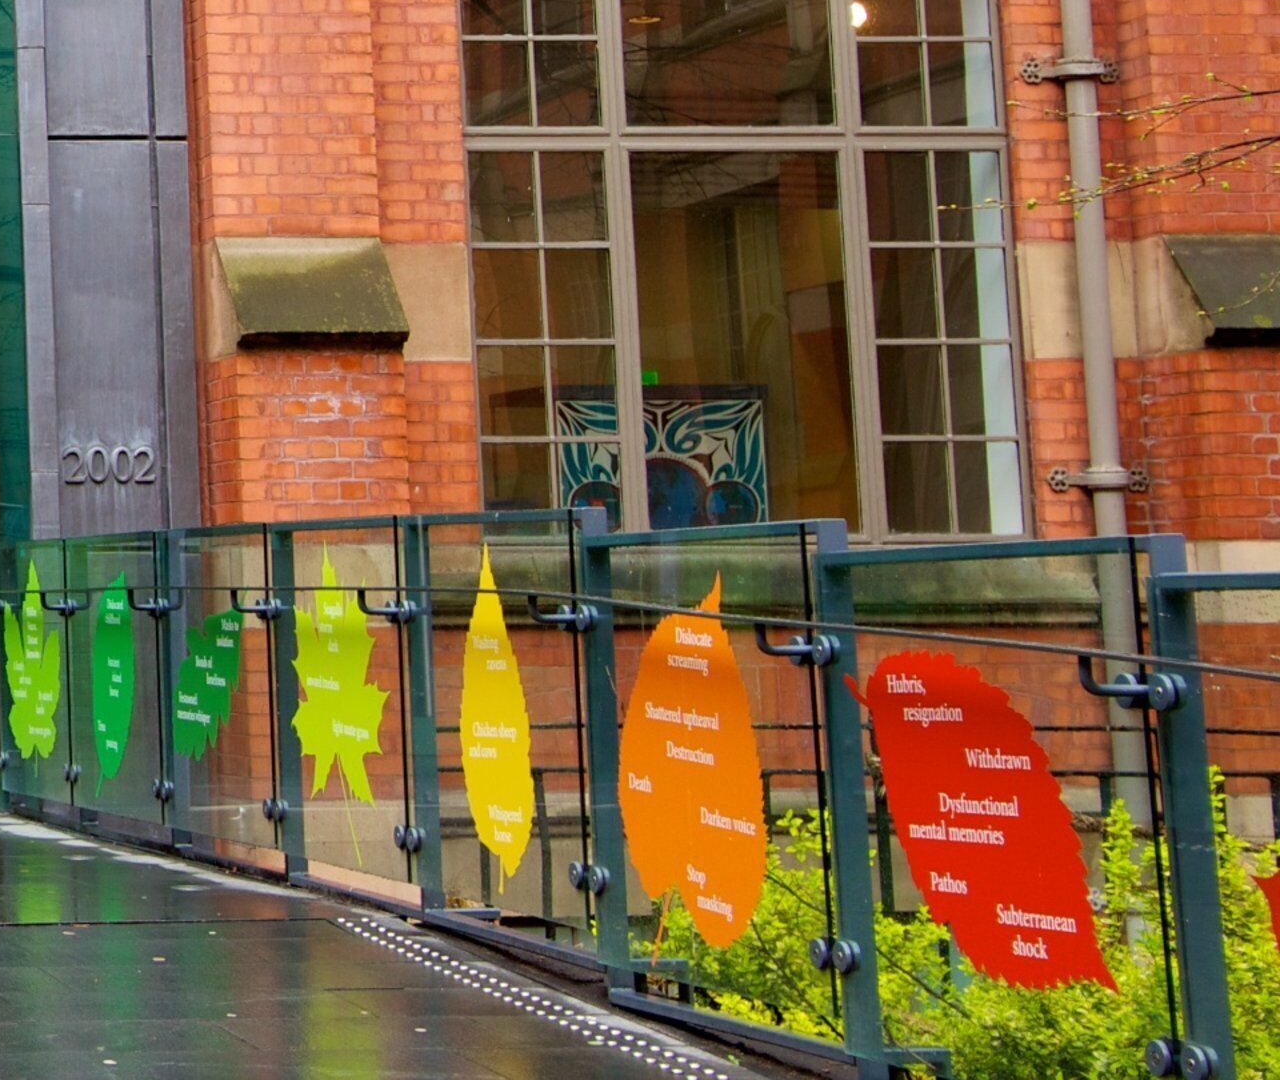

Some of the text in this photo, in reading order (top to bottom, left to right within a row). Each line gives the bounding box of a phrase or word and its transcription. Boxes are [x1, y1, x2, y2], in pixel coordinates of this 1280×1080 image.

[62, 446, 157, 484] 2002
[675, 627, 713, 648] Dislocate
[667, 652, 709, 676] screaming
[886, 673, 926, 696] Hubris,
[645, 703, 719, 730] Shattered upheaval
[903, 703, 963, 727] resignation
[469, 745, 481, 758] and
[666, 741, 714, 765] Destruction
[965, 748, 1031, 770] Withdrawn
[628, 773, 652, 793] Death
[488, 804, 523, 826] Whispered
[938, 792, 1019, 818] Dysfunctional
[700, 807, 756, 836] Darken voice
[909, 820, 1005, 845] mental memories
[687, 864, 706, 889] Stop
[930, 871, 968, 895] Pathos
[697, 894, 732, 922] masking
[996, 903, 1077, 933] Subterranean
[1013, 935, 1048, 959] shock
